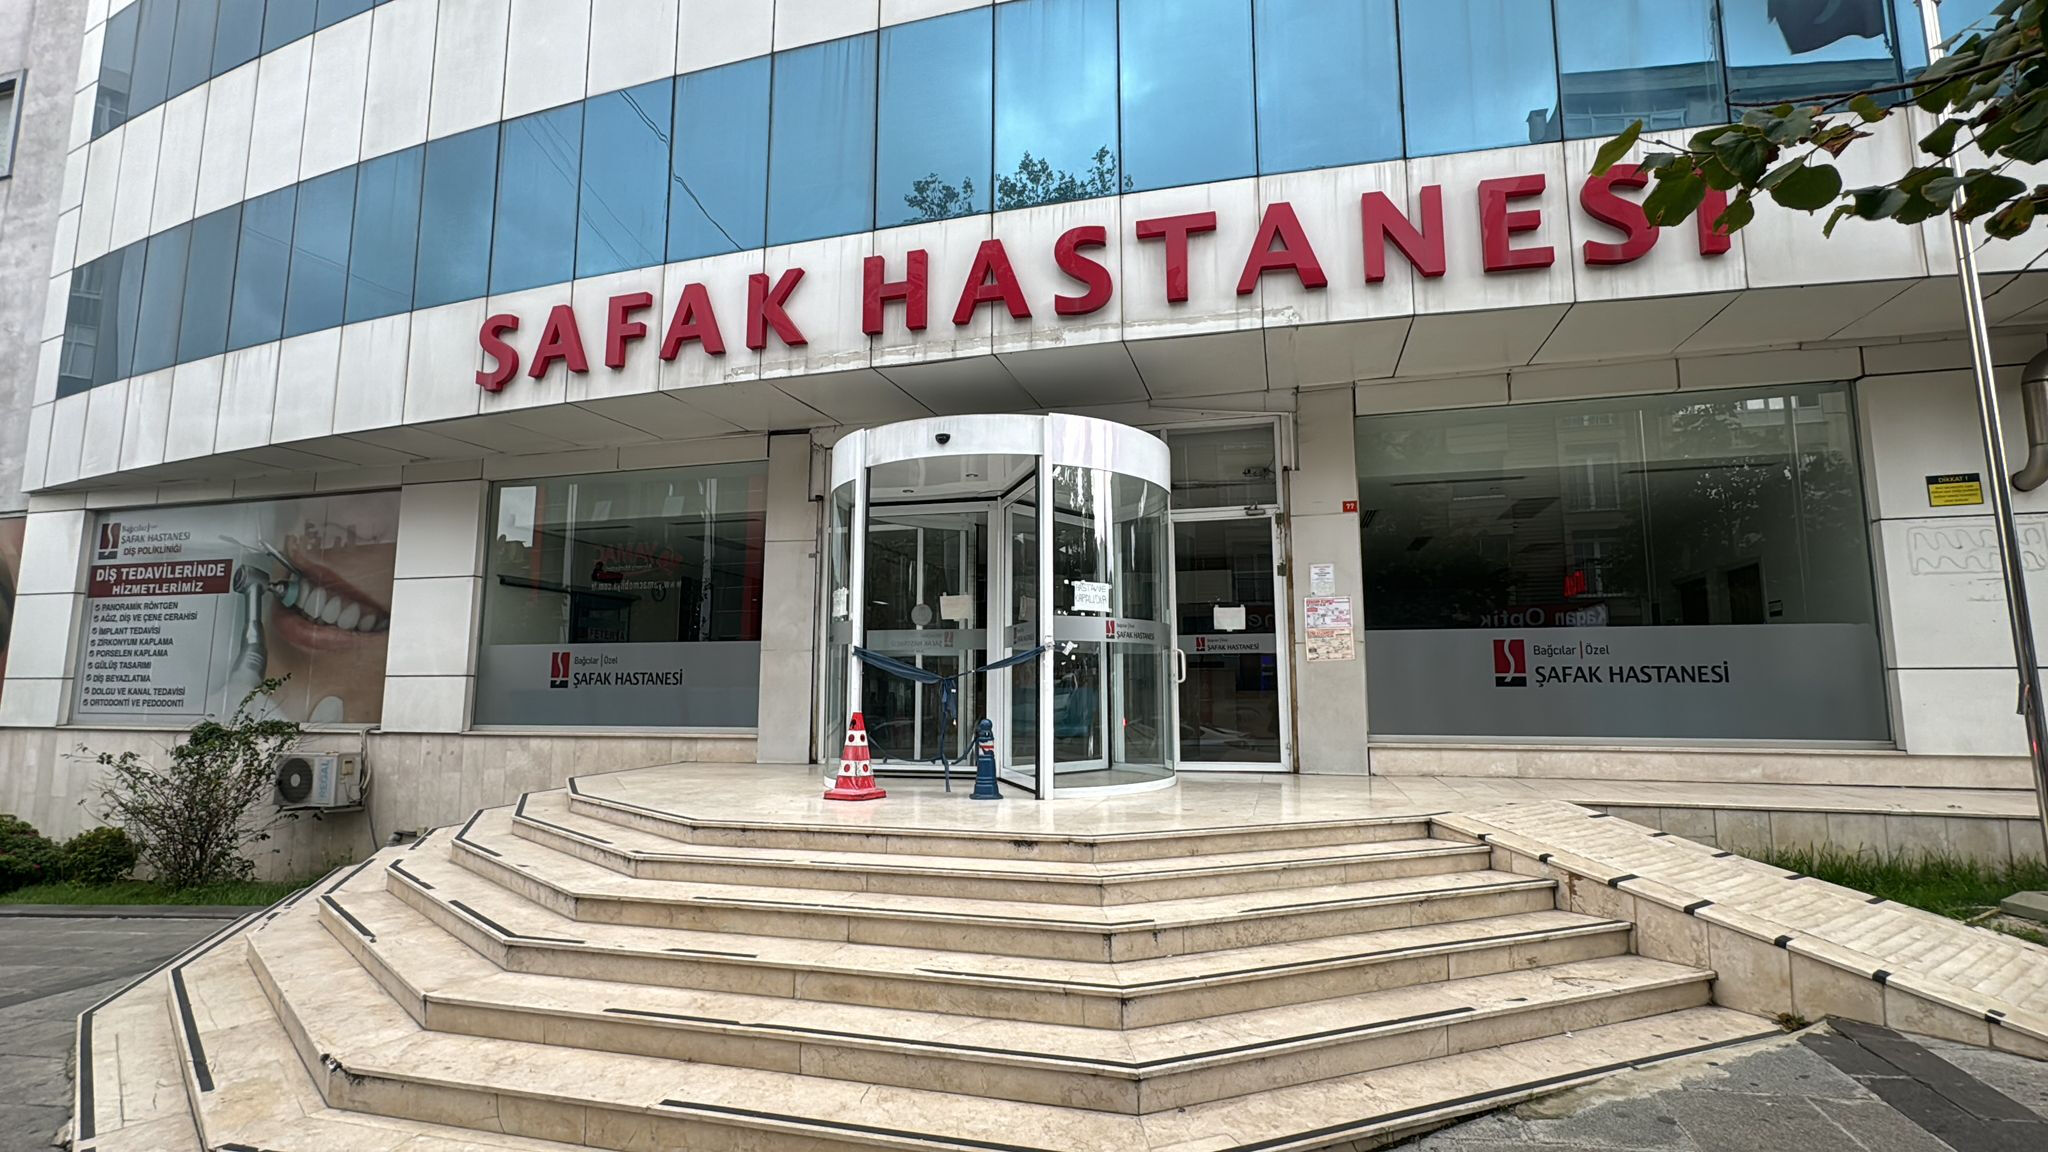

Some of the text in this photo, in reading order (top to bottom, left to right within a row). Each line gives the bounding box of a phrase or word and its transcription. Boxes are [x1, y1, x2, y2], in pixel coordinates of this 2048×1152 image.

[475, 267, 808, 393] ŞAFAK
[96, 561, 226, 584] DİŞ TEDAVİLERİNDE
[112, 580, 204, 596] HİZMETLERİMİZ
[143, 601, 179, 610] RÖNTGEN
[133, 614, 142, 622] VE
[143, 613, 163, 623] ÇENE
[139, 637, 174, 646] KAPLAMA
[133, 648, 169, 657] KAPLAMA
[1533, 642, 1610, 658] Bağcılar Özel
[573, 668, 684, 689] ŞAFAK HASTANESİ
[1535, 661, 1730, 688] ŞAFAK HASTANESİ
[91, 686, 117, 696] DOLGU
[117, 687, 127, 696] VE
[127, 686, 152, 696] KANAL
[131, 698, 141, 708] VE
